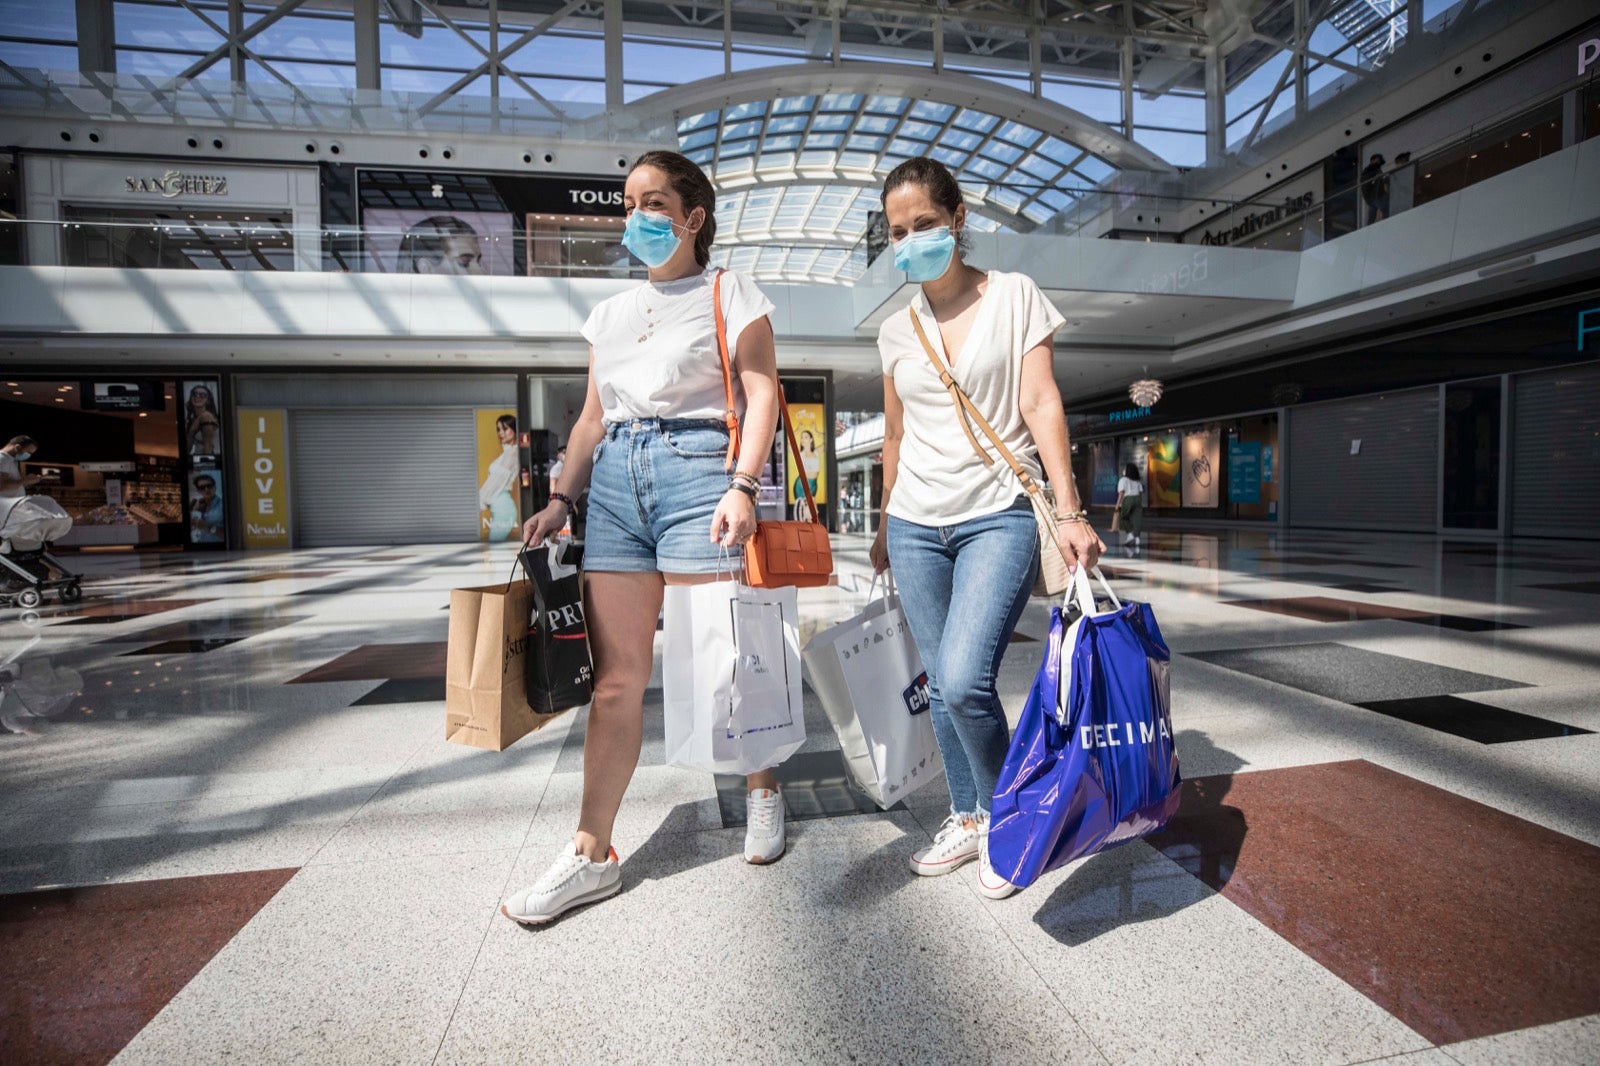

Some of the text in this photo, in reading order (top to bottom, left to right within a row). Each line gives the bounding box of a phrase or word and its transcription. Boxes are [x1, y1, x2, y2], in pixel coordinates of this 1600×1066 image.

[125, 170, 228, 198] SANCHEZ
[568, 189, 623, 205] TOUS
[1109, 404, 1151, 423] PRIMARK
[254, 437, 274, 514] LOVE
[1081, 717, 1170, 750] DECIMA
